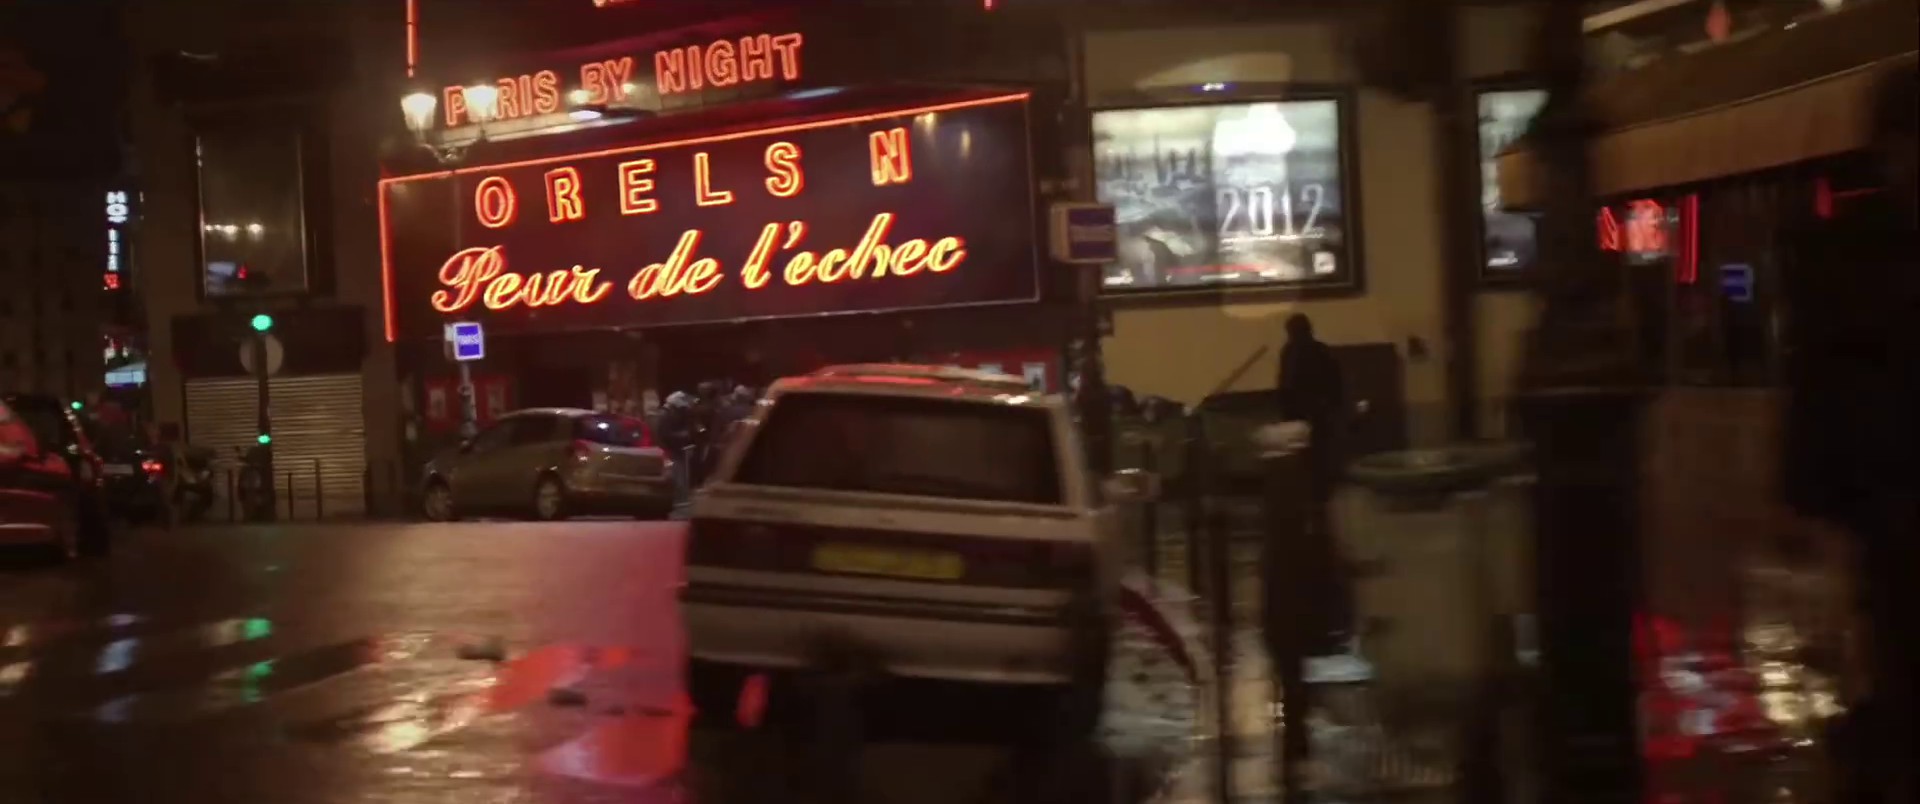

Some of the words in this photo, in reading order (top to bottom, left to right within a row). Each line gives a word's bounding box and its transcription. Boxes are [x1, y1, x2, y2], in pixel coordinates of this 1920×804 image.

[444, 70, 561, 126] PRIS
[580, 58, 633, 105] BY
[655, 33, 803, 94] NIGHT
[1218, 184, 1325, 237] 2012
[430, 244, 612, 313] Peur
[627, 229, 723, 301] de
